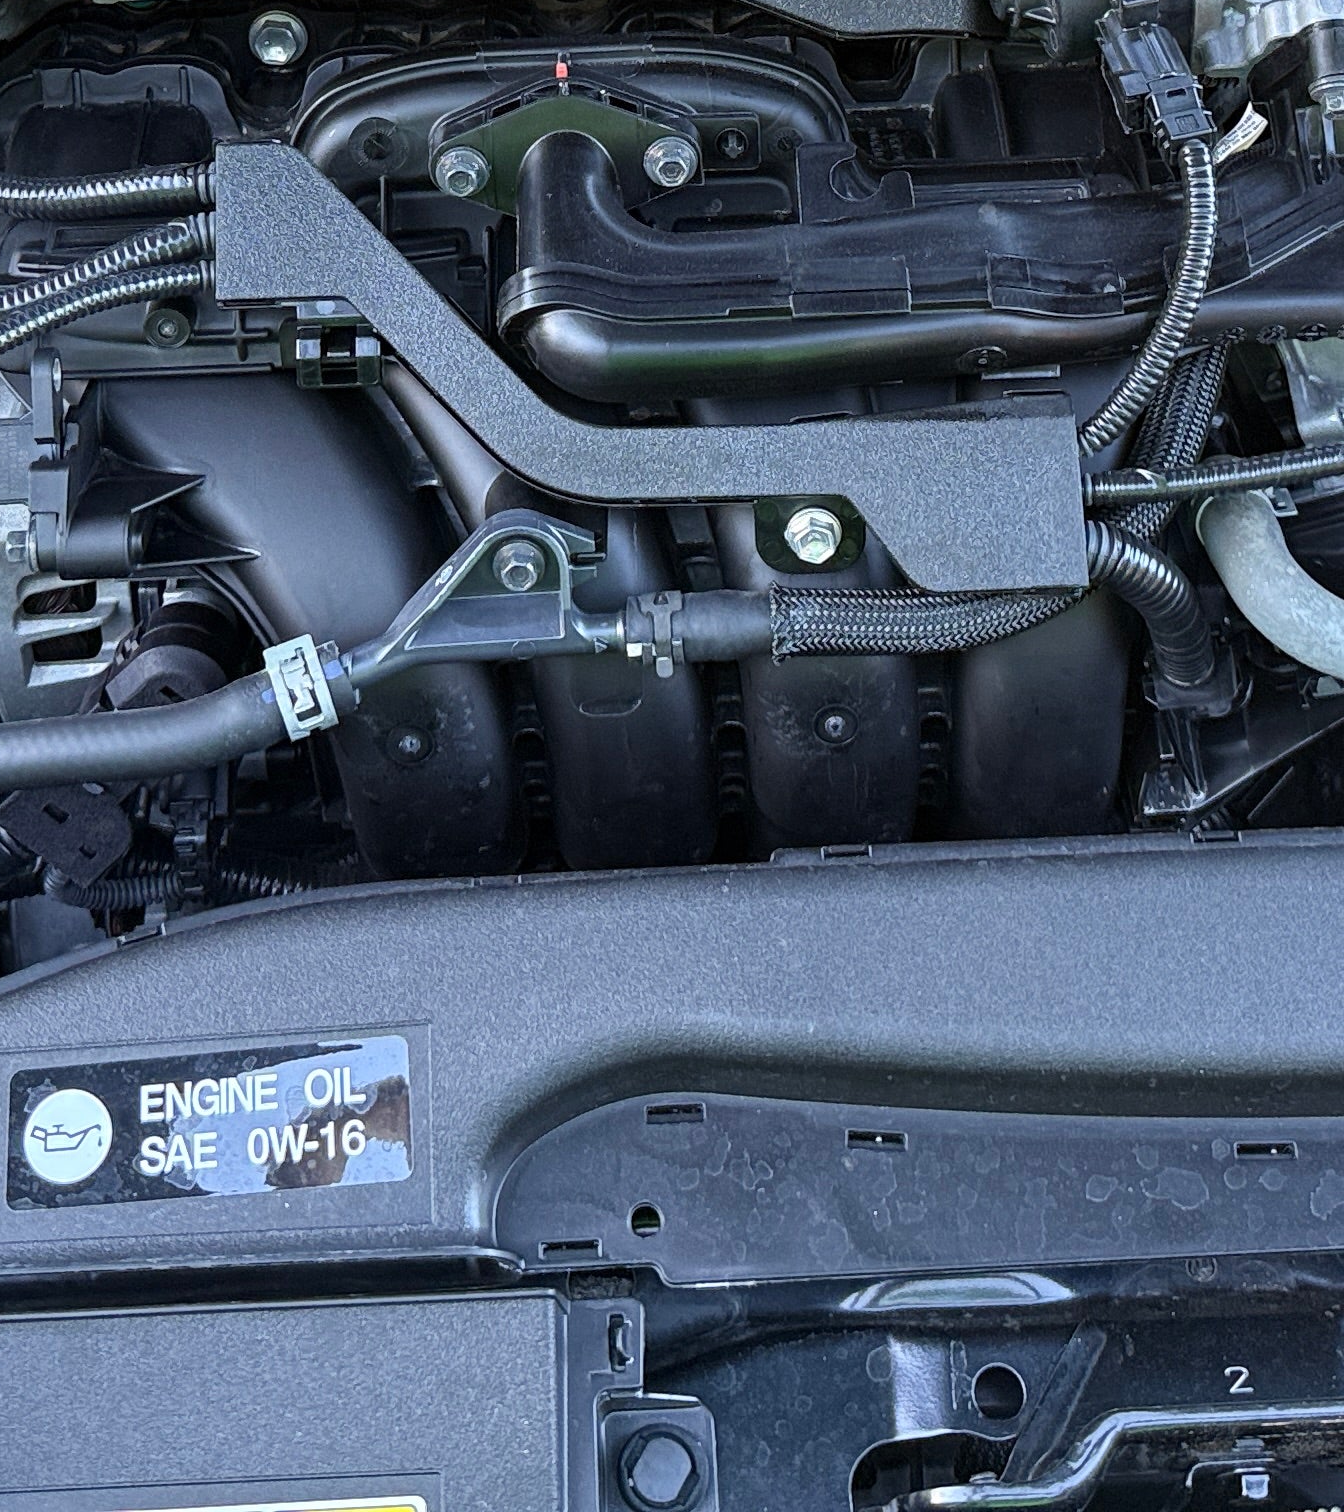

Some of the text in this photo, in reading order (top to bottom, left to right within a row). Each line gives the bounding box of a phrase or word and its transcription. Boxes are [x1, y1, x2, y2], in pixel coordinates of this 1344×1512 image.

[139, 1066, 367, 1123] ENGINE OIL
[139, 1118, 367, 1177] SAE 0W-16
[1224, 1365, 1254, 1395] 2
